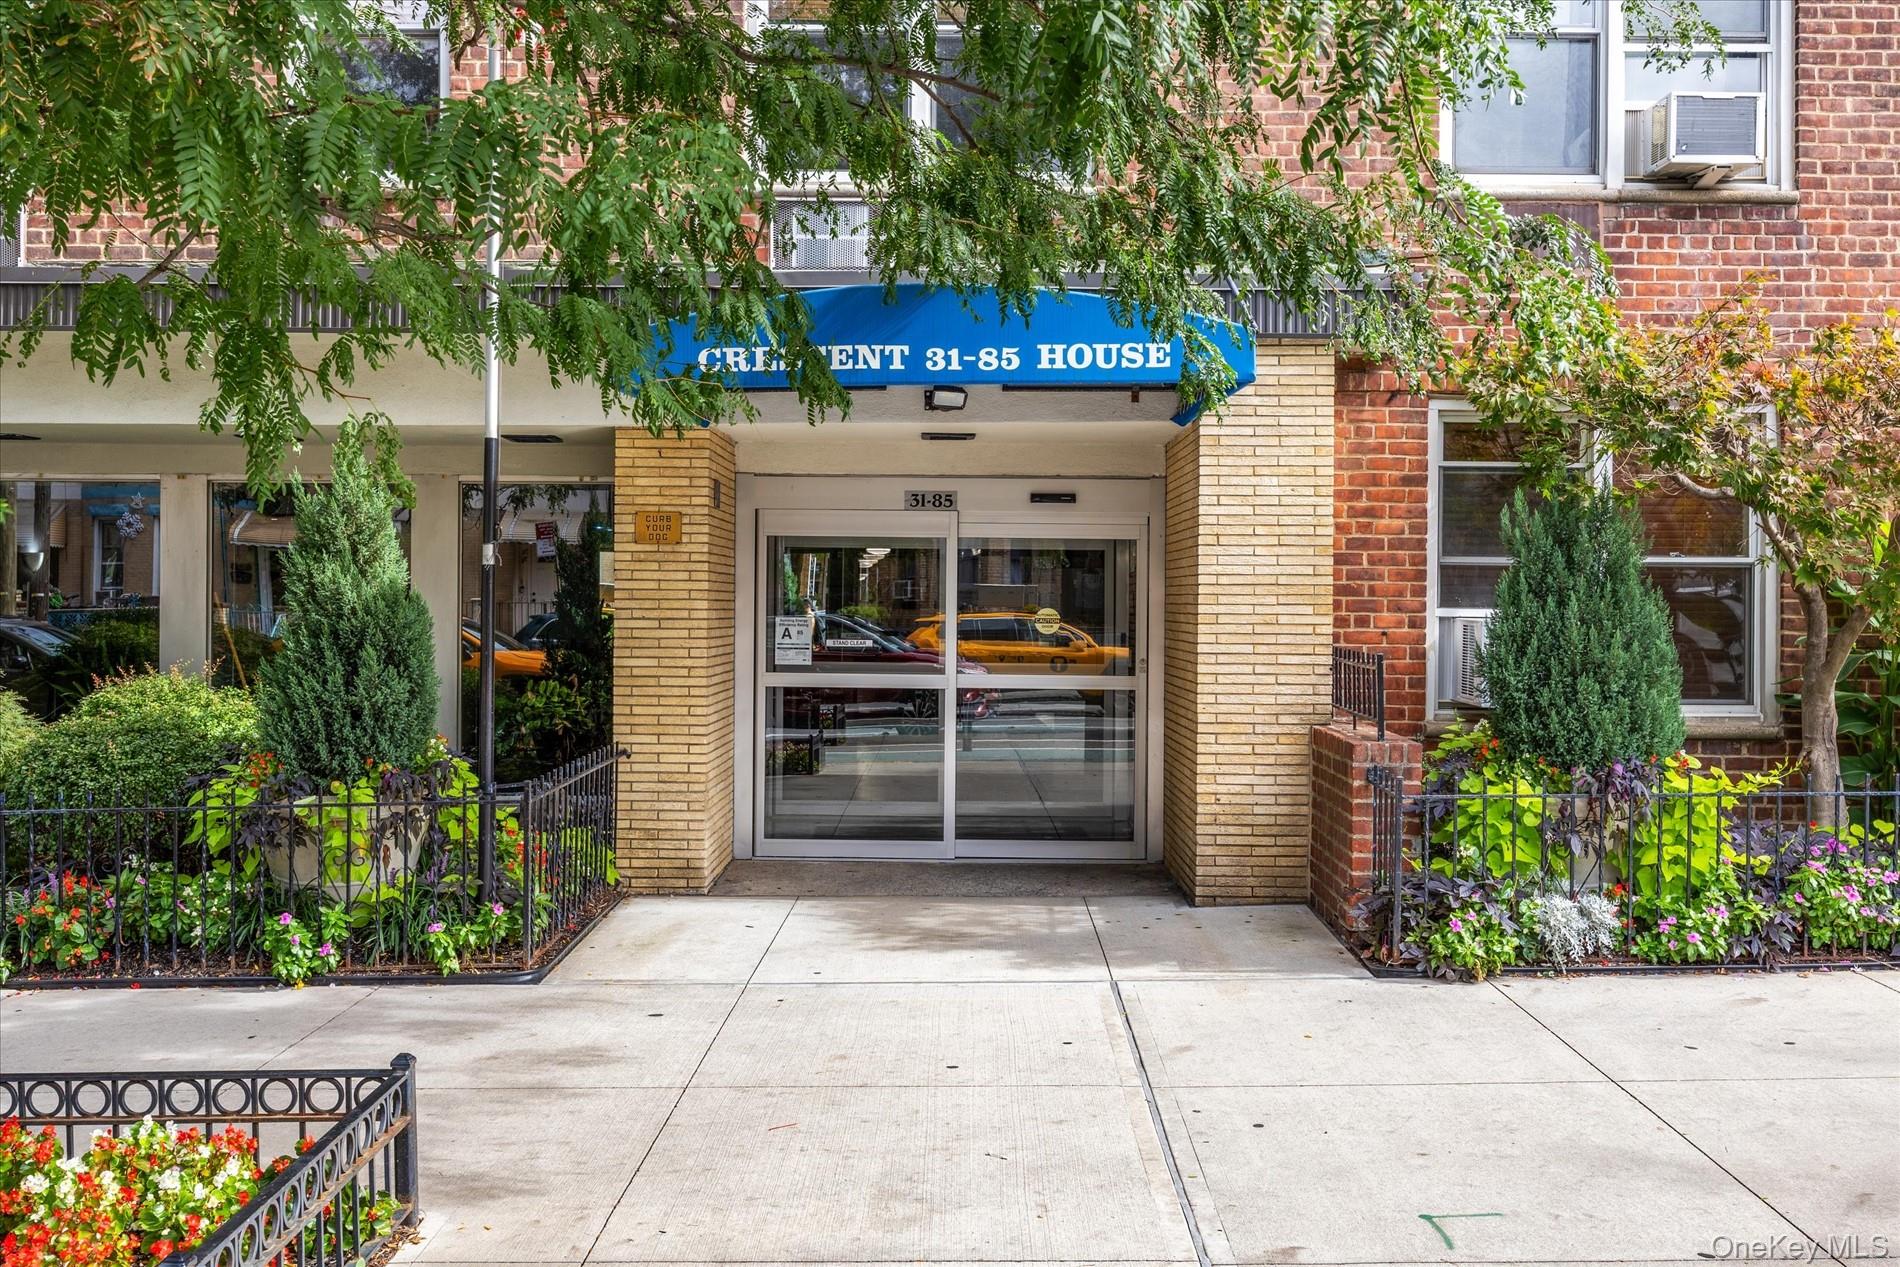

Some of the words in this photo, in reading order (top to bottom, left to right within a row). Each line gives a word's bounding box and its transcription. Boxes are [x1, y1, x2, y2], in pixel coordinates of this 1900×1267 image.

[698, 345, 908, 372] CREENT
[925, 347, 1020, 371] 31-85
[1037, 343, 1171, 369] HOUSE
[910, 493, 953, 508] 31-85
[645, 515, 672, 523] CURB
[645, 524, 672, 532] YOUR
[648, 533, 668, 541] DOG
[781, 628, 792, 640] A
